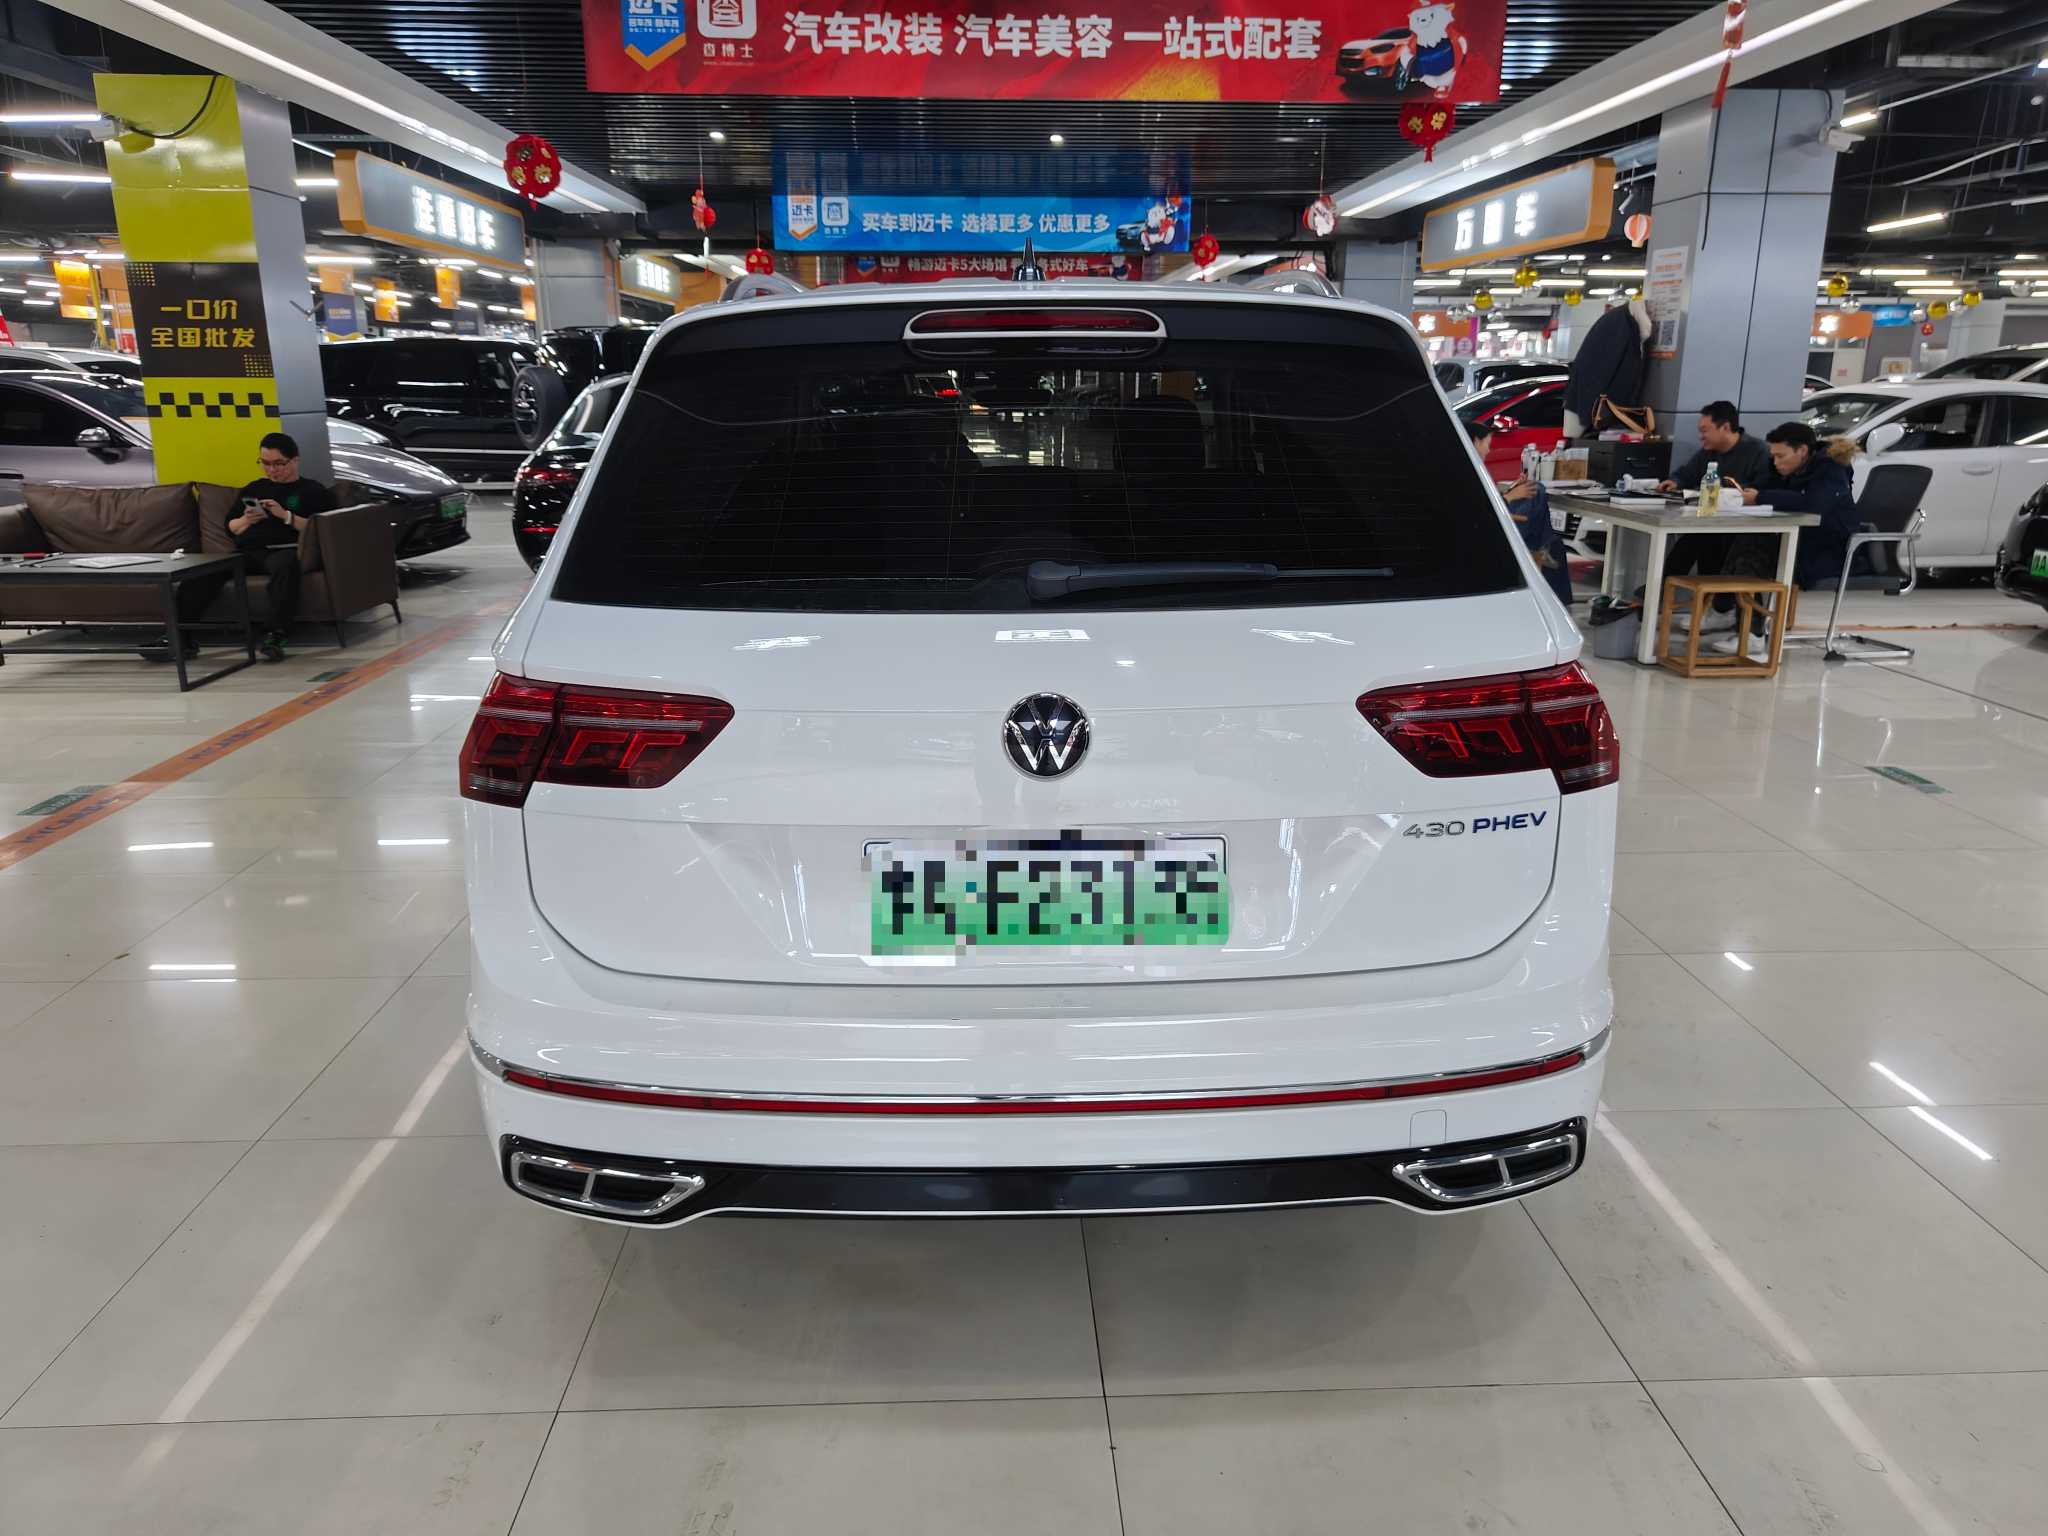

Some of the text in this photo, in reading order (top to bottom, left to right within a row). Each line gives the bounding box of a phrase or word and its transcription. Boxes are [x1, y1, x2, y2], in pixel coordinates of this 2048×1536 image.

[783, 10, 1323, 60] 汽车改装 汽车美容 一站式配套
[862, 212, 1110, 233] 买车到迈卡 选择更多 优惠更多
[160, 299, 238, 320] 一口价
[150, 327, 256, 348] 全国批发
[1402, 810, 1547, 839] 430 PHEV
